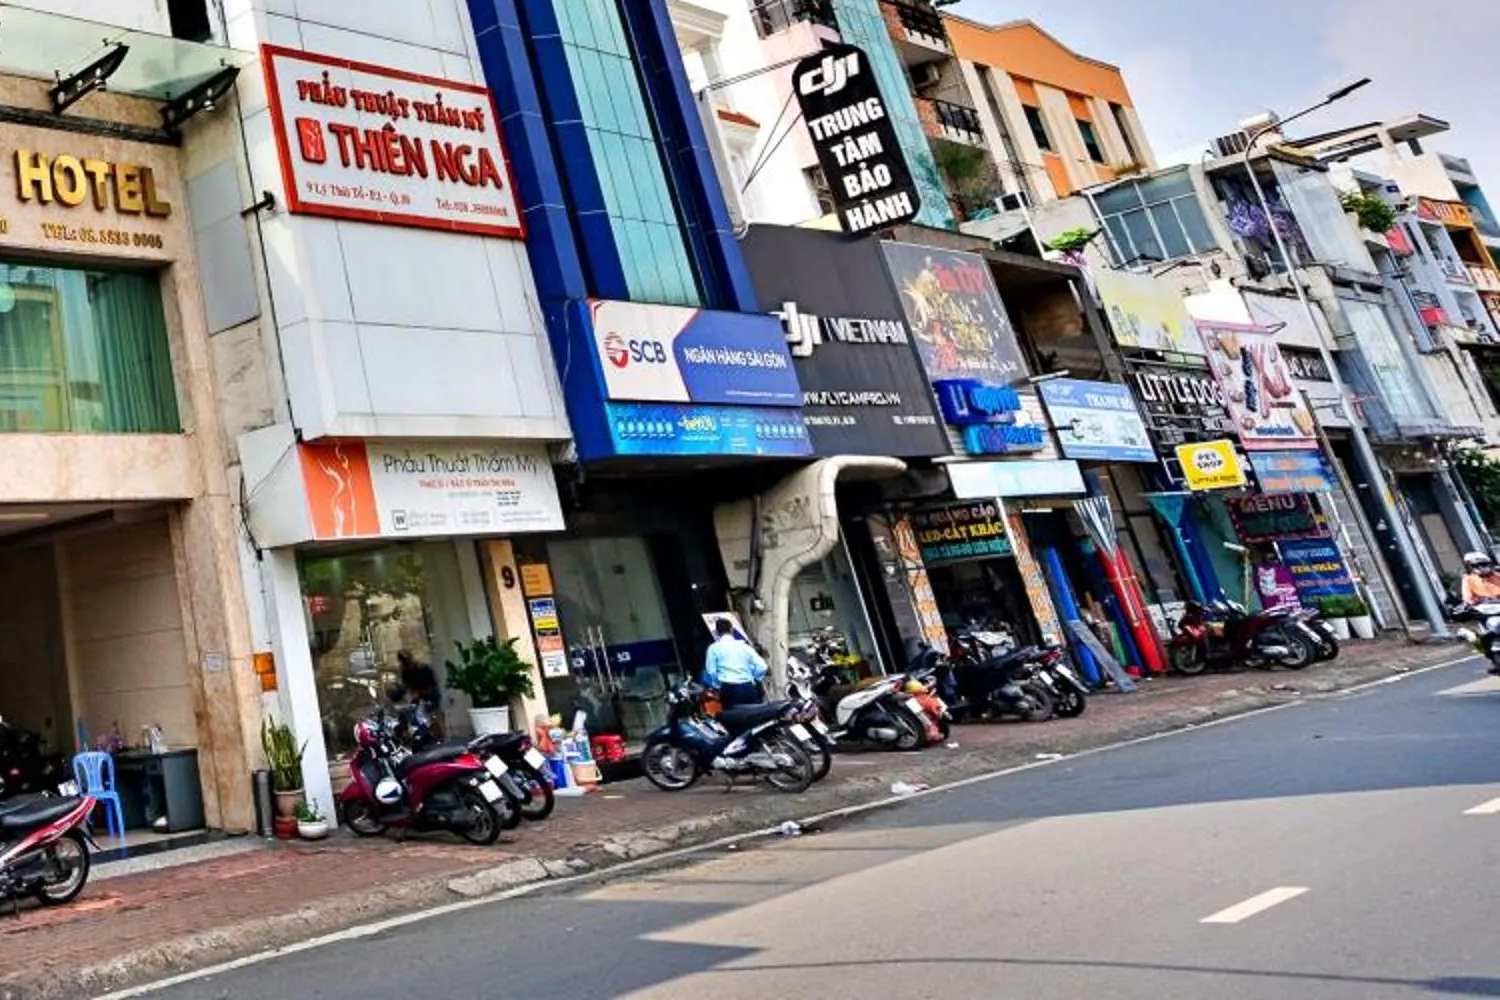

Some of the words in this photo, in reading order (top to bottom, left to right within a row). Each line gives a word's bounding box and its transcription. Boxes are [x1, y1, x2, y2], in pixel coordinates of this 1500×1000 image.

[808, 97, 884, 141] TRUNG
[328, 121, 428, 180] THIÊN
[430, 139, 503, 190] NGA
[830, 131, 884, 167] TÂM
[16, 148, 172, 218] HOTEL
[843, 162, 892, 198] BẢO
[845, 192, 913, 232] HÀNH
[629, 339, 667, 363] SCB
[502, 565, 514, 588] 9
